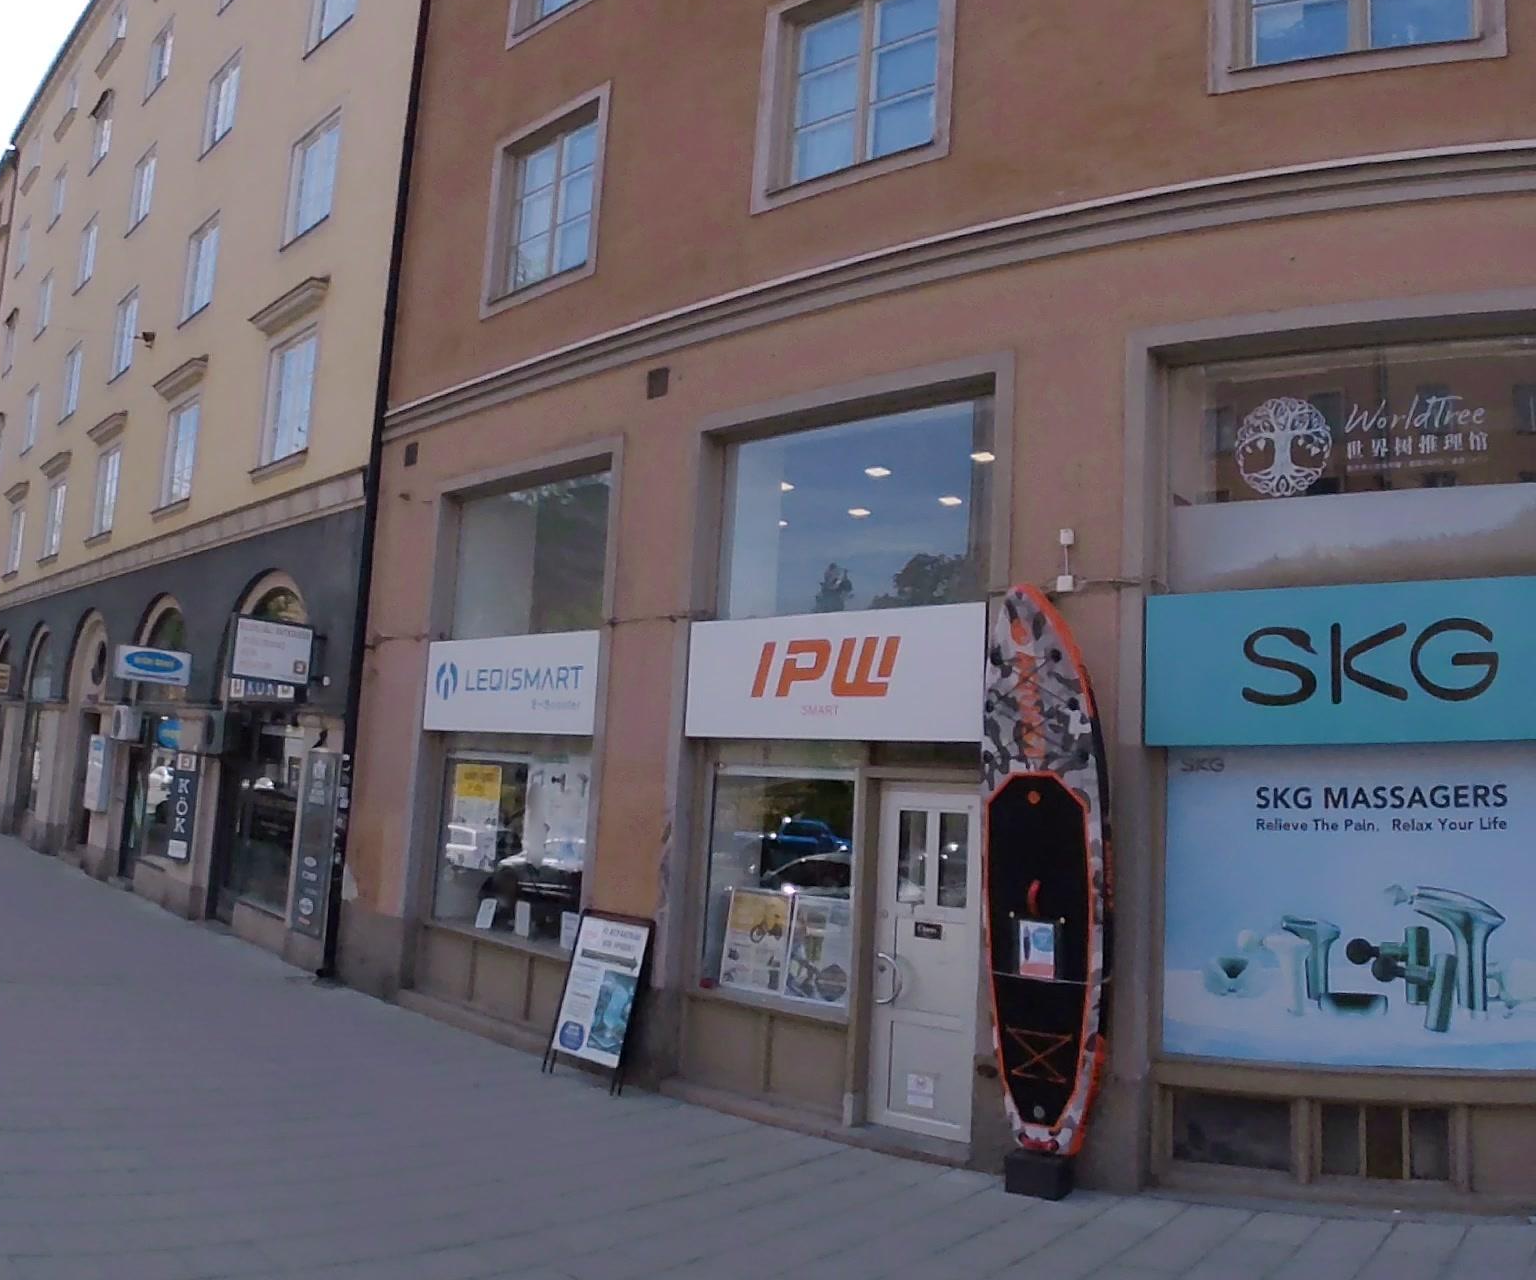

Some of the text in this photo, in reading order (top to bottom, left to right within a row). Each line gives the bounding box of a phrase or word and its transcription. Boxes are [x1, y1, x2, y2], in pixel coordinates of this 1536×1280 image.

[750, 634, 901, 698] IPW
[1242, 617, 1499, 706] SKG
[800, 704, 839, 716] SMART
[1180, 757, 1225, 773] SKG
[1255, 784, 1509, 810] SKG MASSAGERS
[1256, 818, 1309, 831] Relieve
[1313, 818, 1339, 831] The
[1392, 818, 1433, 831] Relax
[1438, 818, 1475, 831] Your
[1479, 817, 1508, 830] Life
